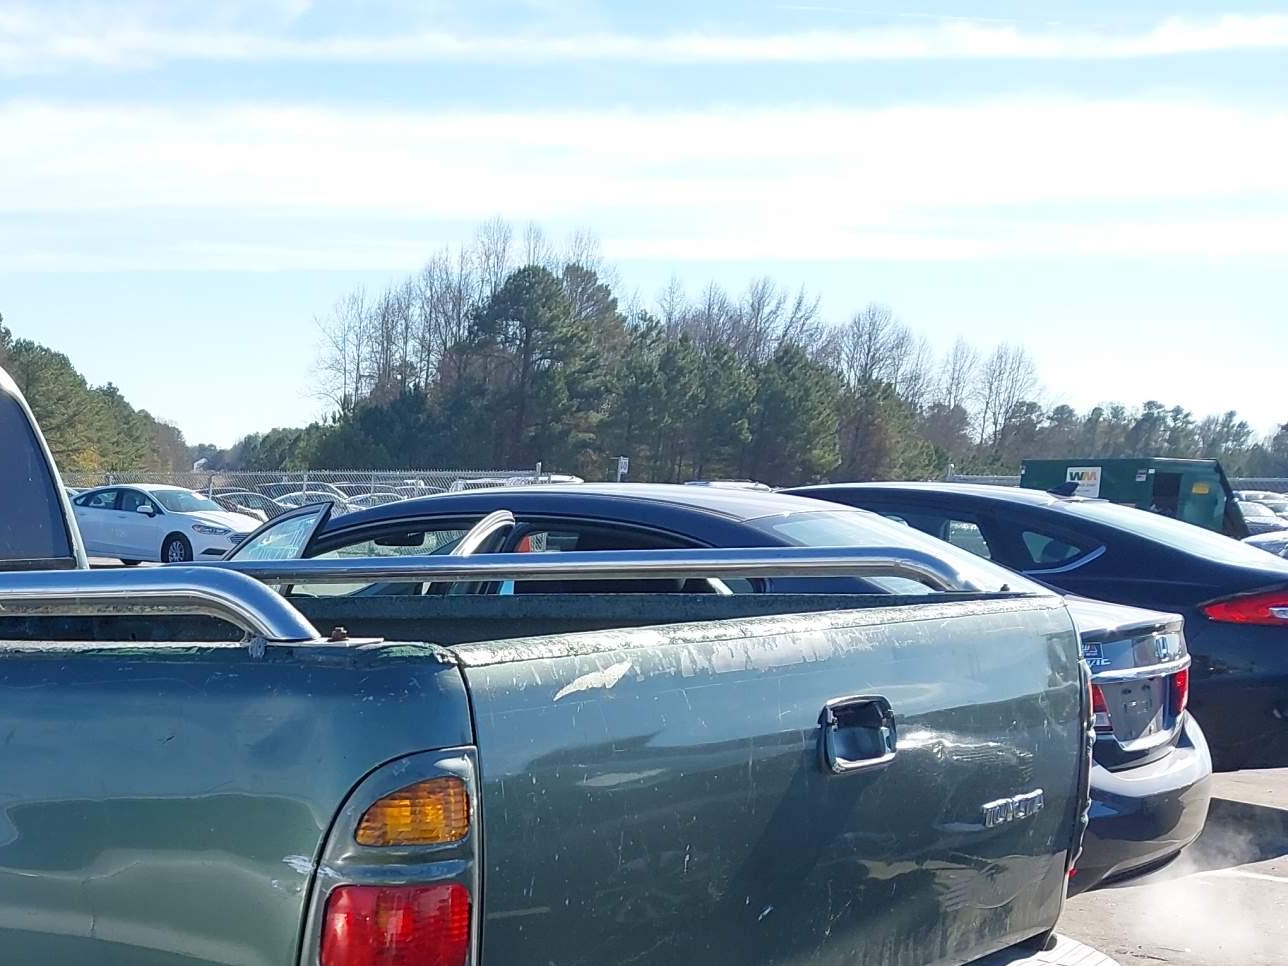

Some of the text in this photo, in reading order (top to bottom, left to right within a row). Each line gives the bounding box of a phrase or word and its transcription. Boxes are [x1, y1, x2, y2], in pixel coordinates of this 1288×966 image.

[1069, 471, 1097, 481] WM
[1086, 657, 1113, 668] VIC
[982, 788, 1044, 828] TOYOTA
